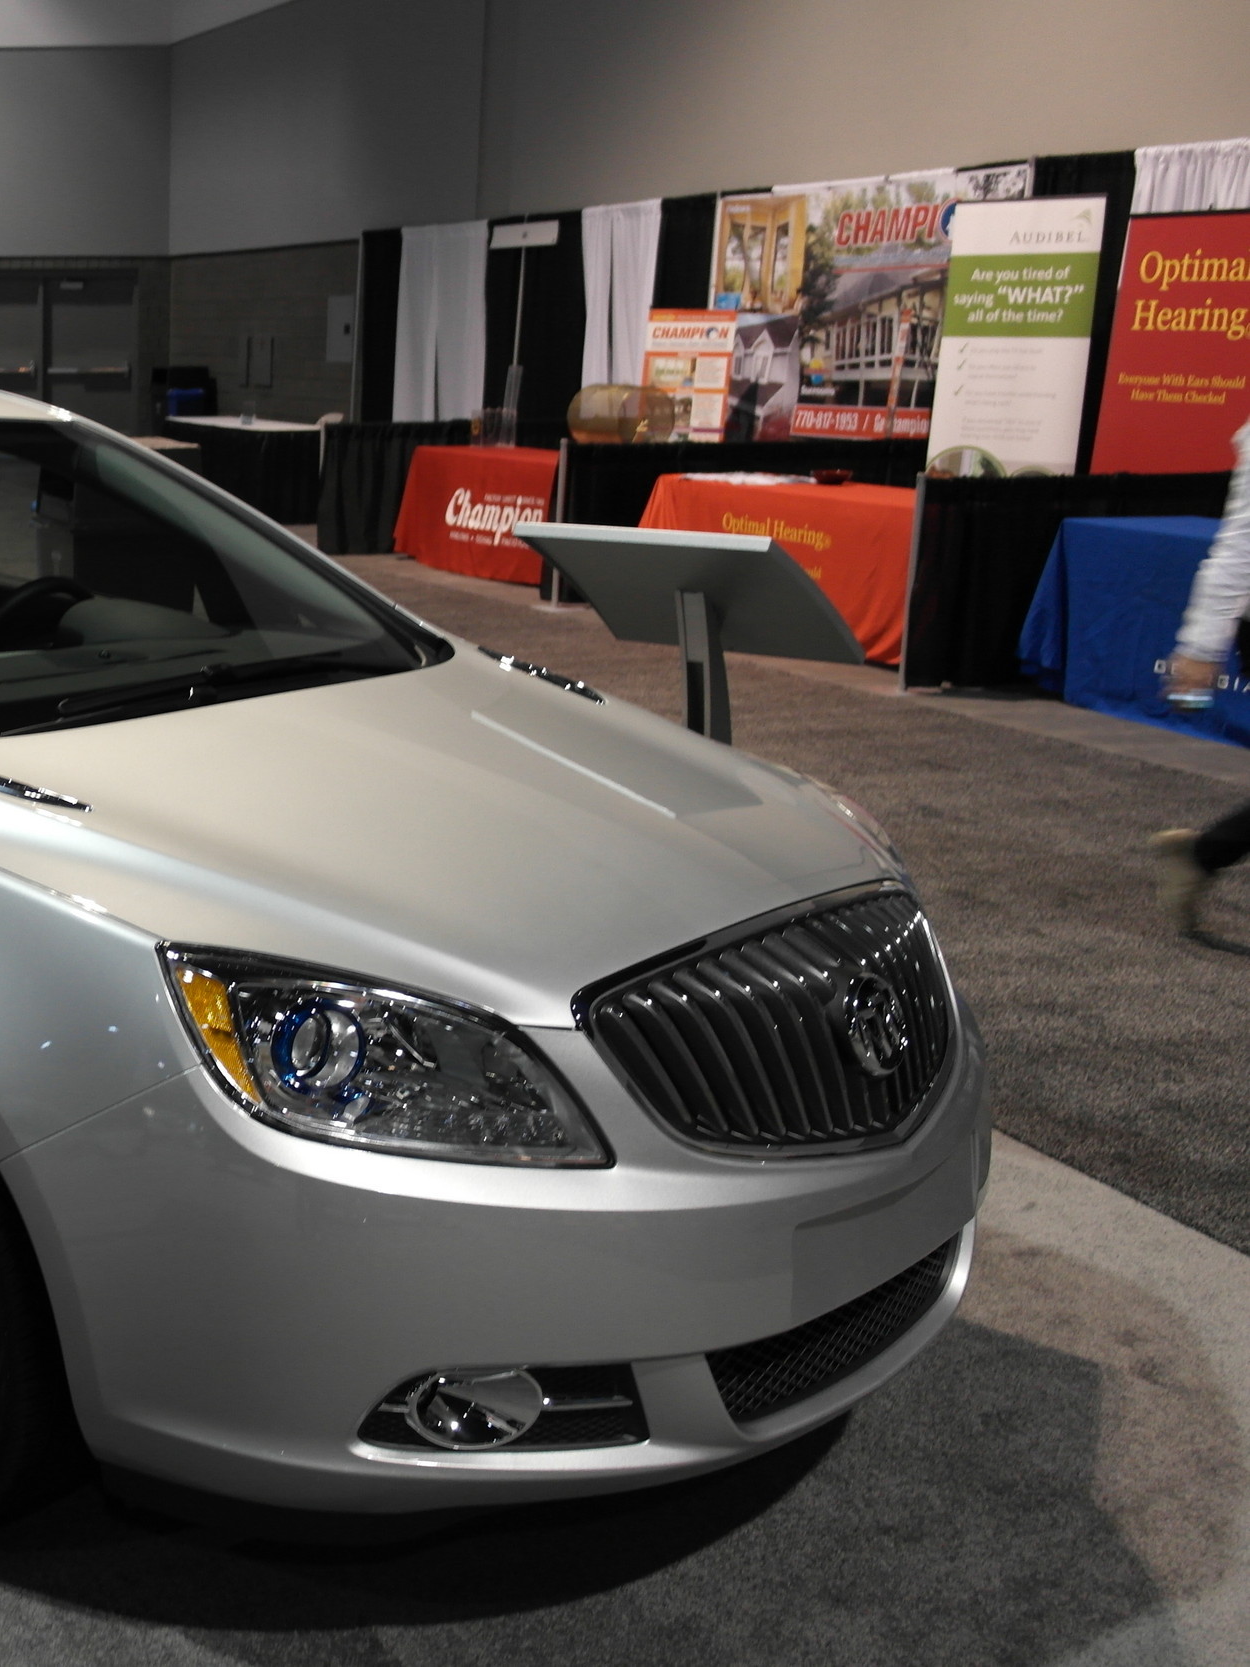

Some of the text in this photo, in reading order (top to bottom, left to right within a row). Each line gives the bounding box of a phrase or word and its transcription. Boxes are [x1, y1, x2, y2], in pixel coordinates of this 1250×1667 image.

[835, 198, 957, 248] CHAMPI
[1009, 230, 1086, 245] AUDIBEL
[971, 265, 1071, 285] Are you tired of
[1139, 248, 1250, 291] Optima
[953, 291, 995, 308] saying
[967, 308, 1064, 323] all of the time?
[1162, 373, 1185, 387] With
[1211, 374, 1246, 389] Should
[1130, 388, 1227, 405] Have Them Checked
[444, 487, 543, 547] Champion
[722, 511, 771, 536] Optimal
